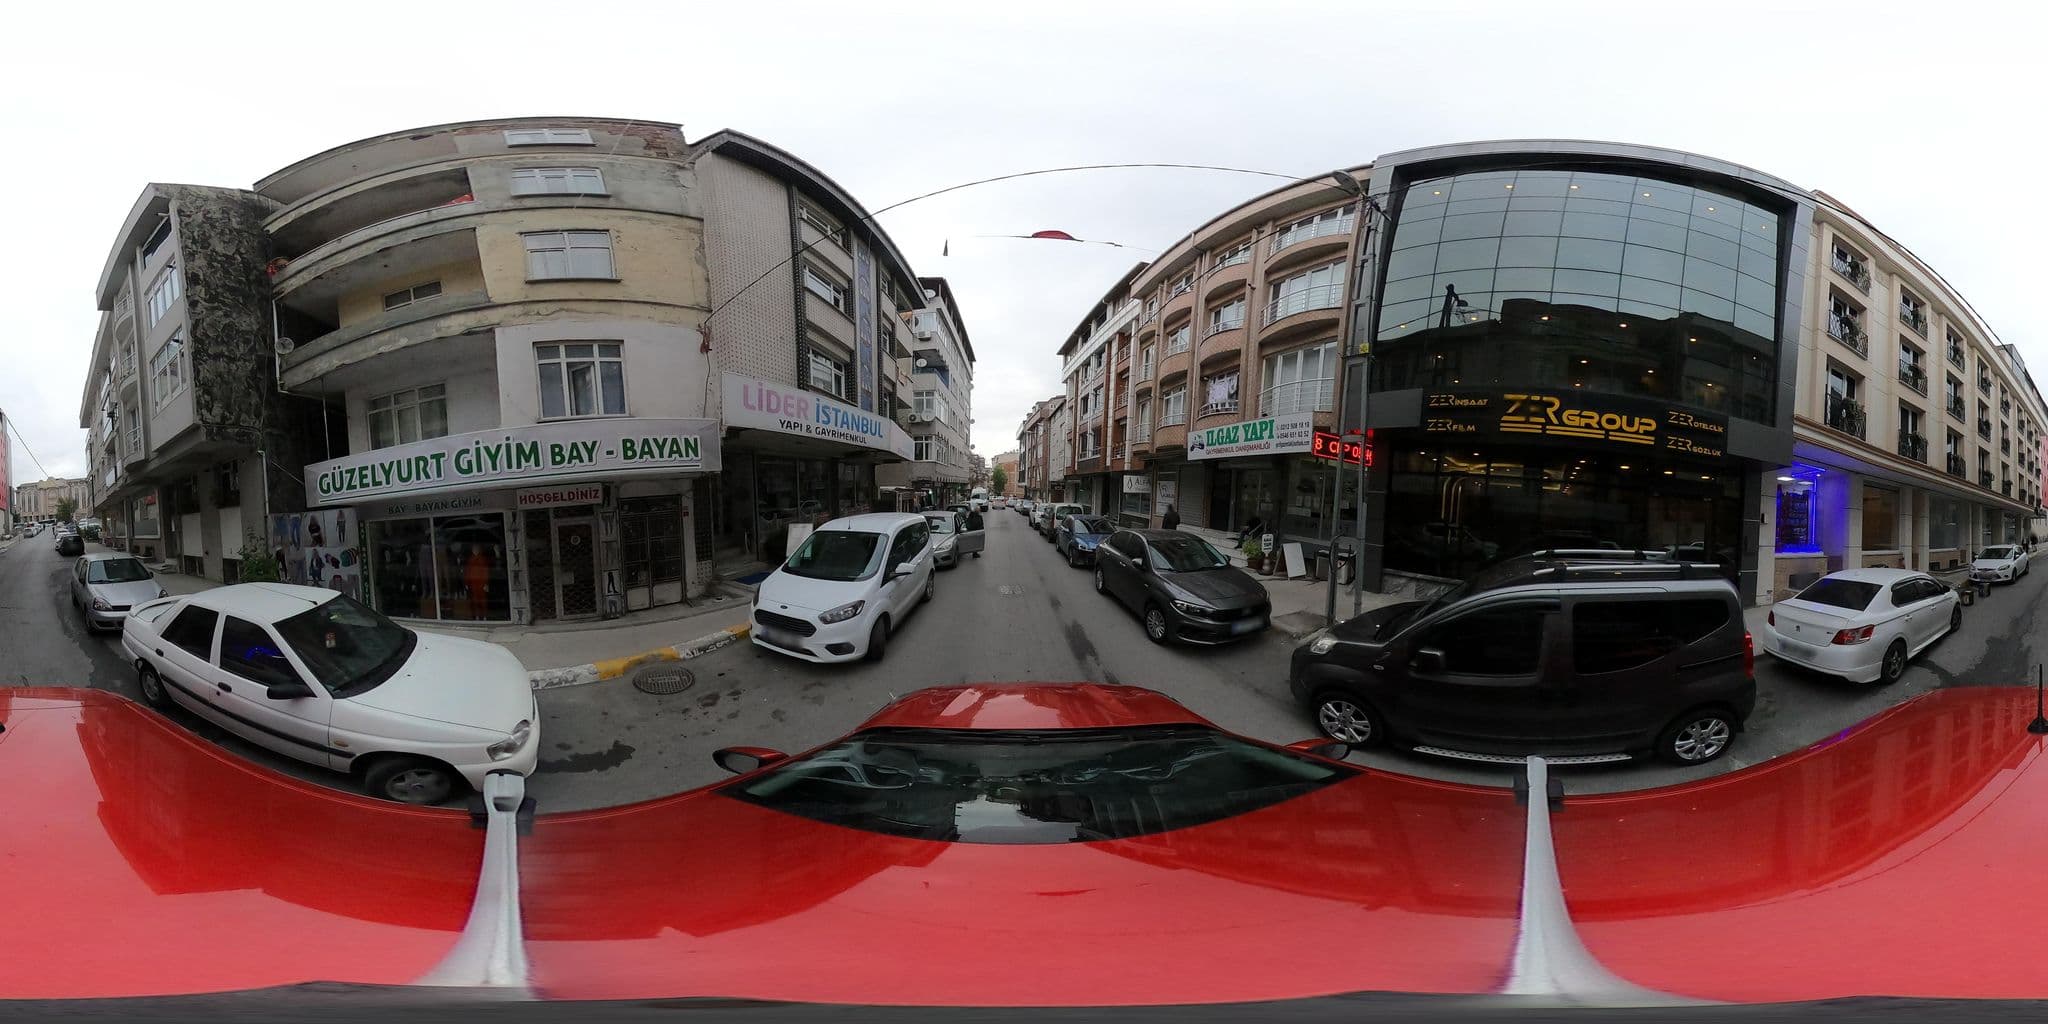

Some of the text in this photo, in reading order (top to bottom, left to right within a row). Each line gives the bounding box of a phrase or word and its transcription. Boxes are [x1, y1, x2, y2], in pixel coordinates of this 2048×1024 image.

[743, 382, 884, 439] LİDER İSTANBUL
[1501, 393, 1657, 433] ZER GROUP
[778, 419, 868, 445] YAPI & GAYRİMENKUL
[1206, 418, 1275, 447] ILGAZ YAPI
[318, 452, 446, 495] GÜZELYURT
[454, 436, 541, 476] GİYİM
[550, 441, 600, 466] BAY
[622, 435, 700, 462] BAYAN
[388, 505, 406, 514] BAY
[415, 501, 449, 513] BAYAN
[450, 496, 482, 511] GİYİM
[518, 486, 601, 505] HOŞGELDİNİZ
